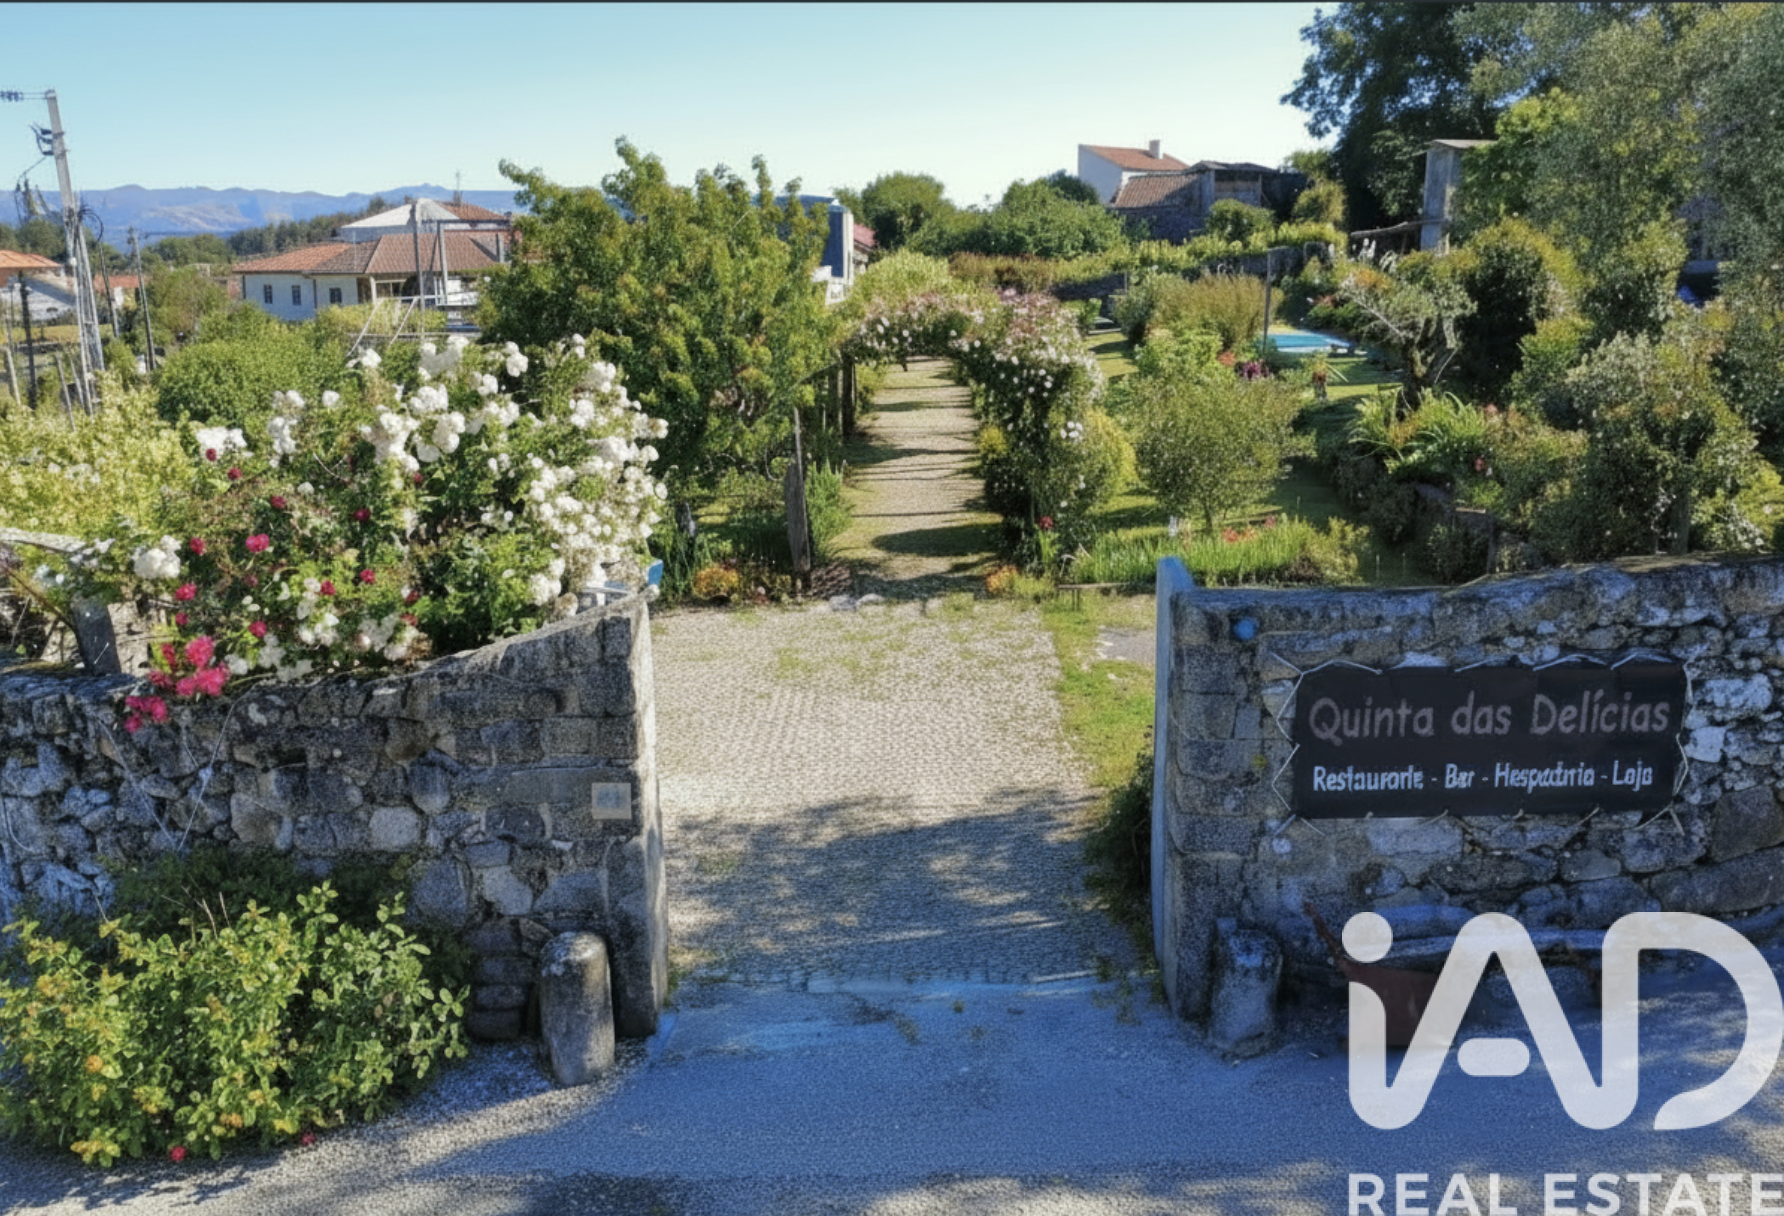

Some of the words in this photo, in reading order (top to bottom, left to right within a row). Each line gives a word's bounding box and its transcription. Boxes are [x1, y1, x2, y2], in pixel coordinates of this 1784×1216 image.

[1308, 695, 1435, 747] Quinta
[1450, 690, 1512, 736] das
[1529, 688, 1671, 736] Delícias
[1443, 762, 1477, 789] Bar
[1611, 758, 1653, 793] Loja
